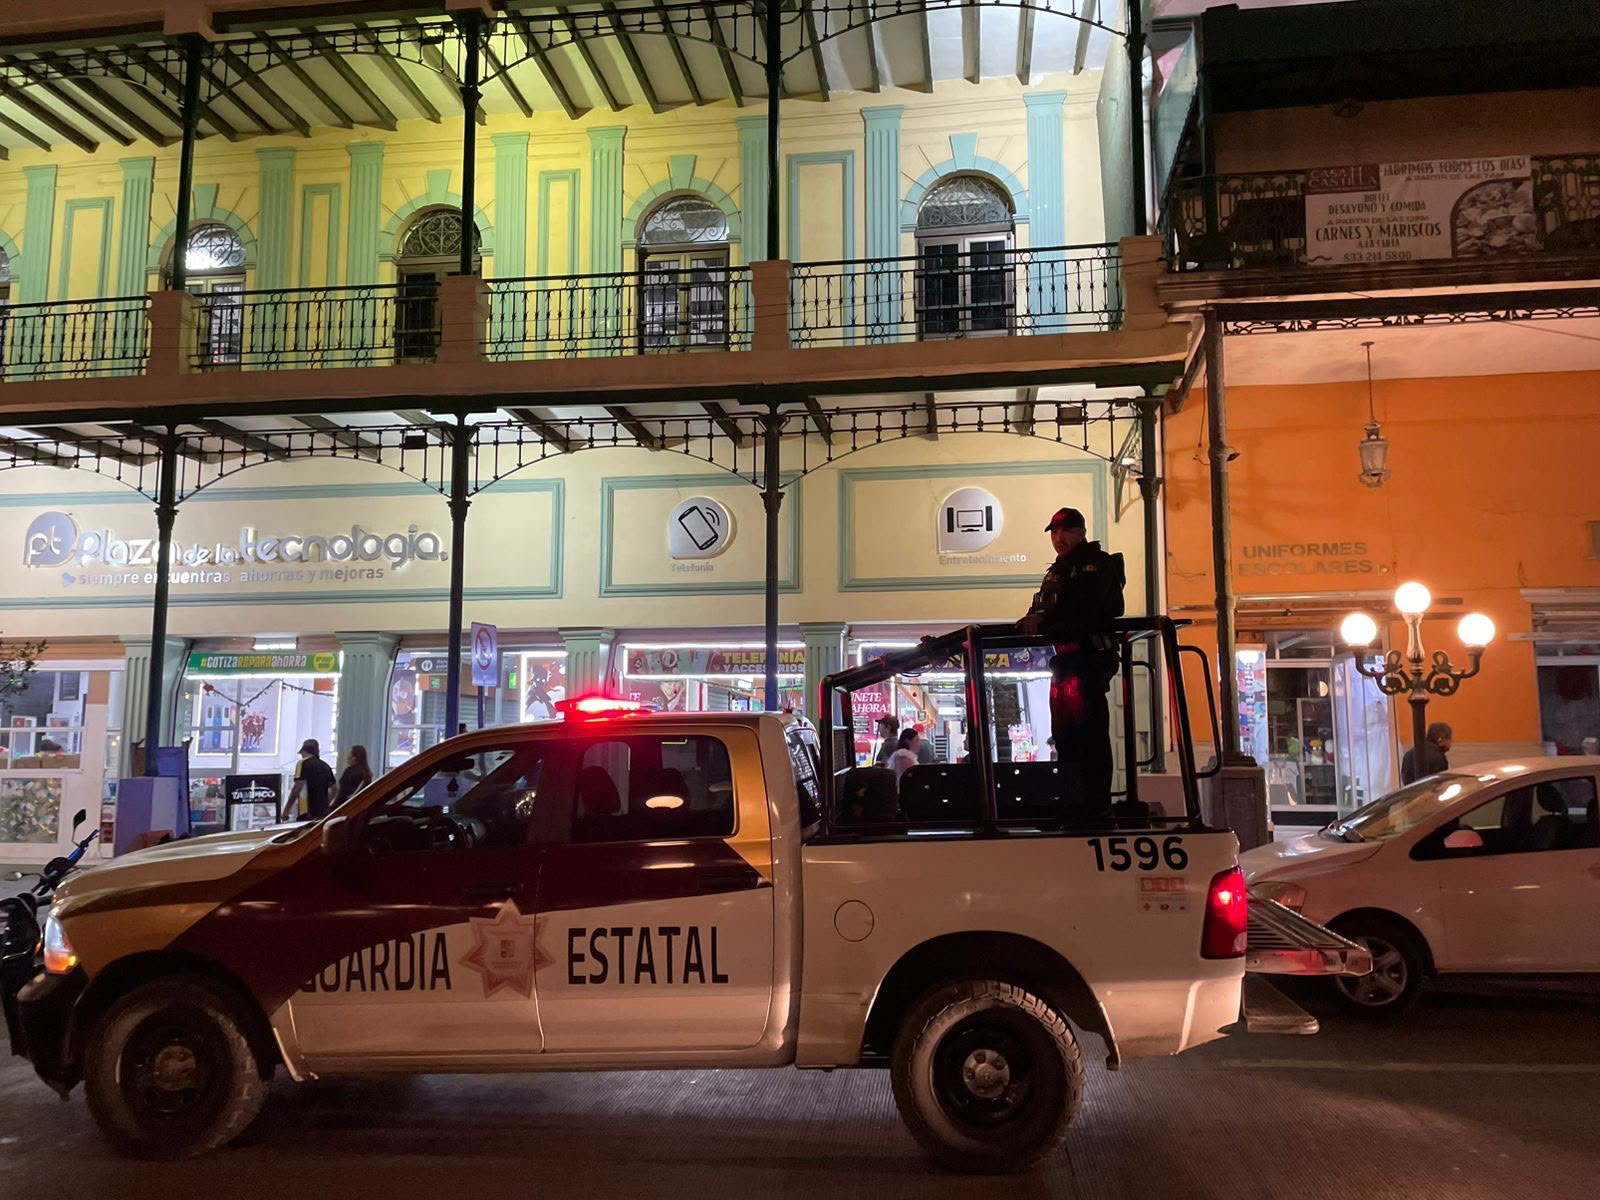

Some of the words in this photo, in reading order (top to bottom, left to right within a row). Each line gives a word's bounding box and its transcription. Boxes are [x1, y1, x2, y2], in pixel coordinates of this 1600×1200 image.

[1439, 159, 1472, 173] TODOS
[1476, 158, 1495, 171] LOS
[1328, 202, 1377, 215] DESAYUNO
[1380, 201, 1387, 212] Y
[1390, 200, 1426, 211] COMIDA
[1315, 224, 1362, 241] CARNES
[1366, 224, 1375, 239] Y
[1379, 220, 1442, 238] MARISCOS
[184, 543, 212, 565] de
[216, 543, 238, 564] la
[1243, 542, 1368, 558] UNIFORMES
[1238, 560, 1373, 576] ESCOLARES
[79, 572, 139, 587] siempre
[240, 568, 303, 583] ahorras
[308, 570, 316, 583] y
[320, 567, 384, 582] mejoras
[723, 651, 805, 664] TELEFNÍA
[231, 790, 276, 800] TAMPICO
[1088, 836, 1188, 872] 1596
[567, 925, 729, 984] ESTATAL
